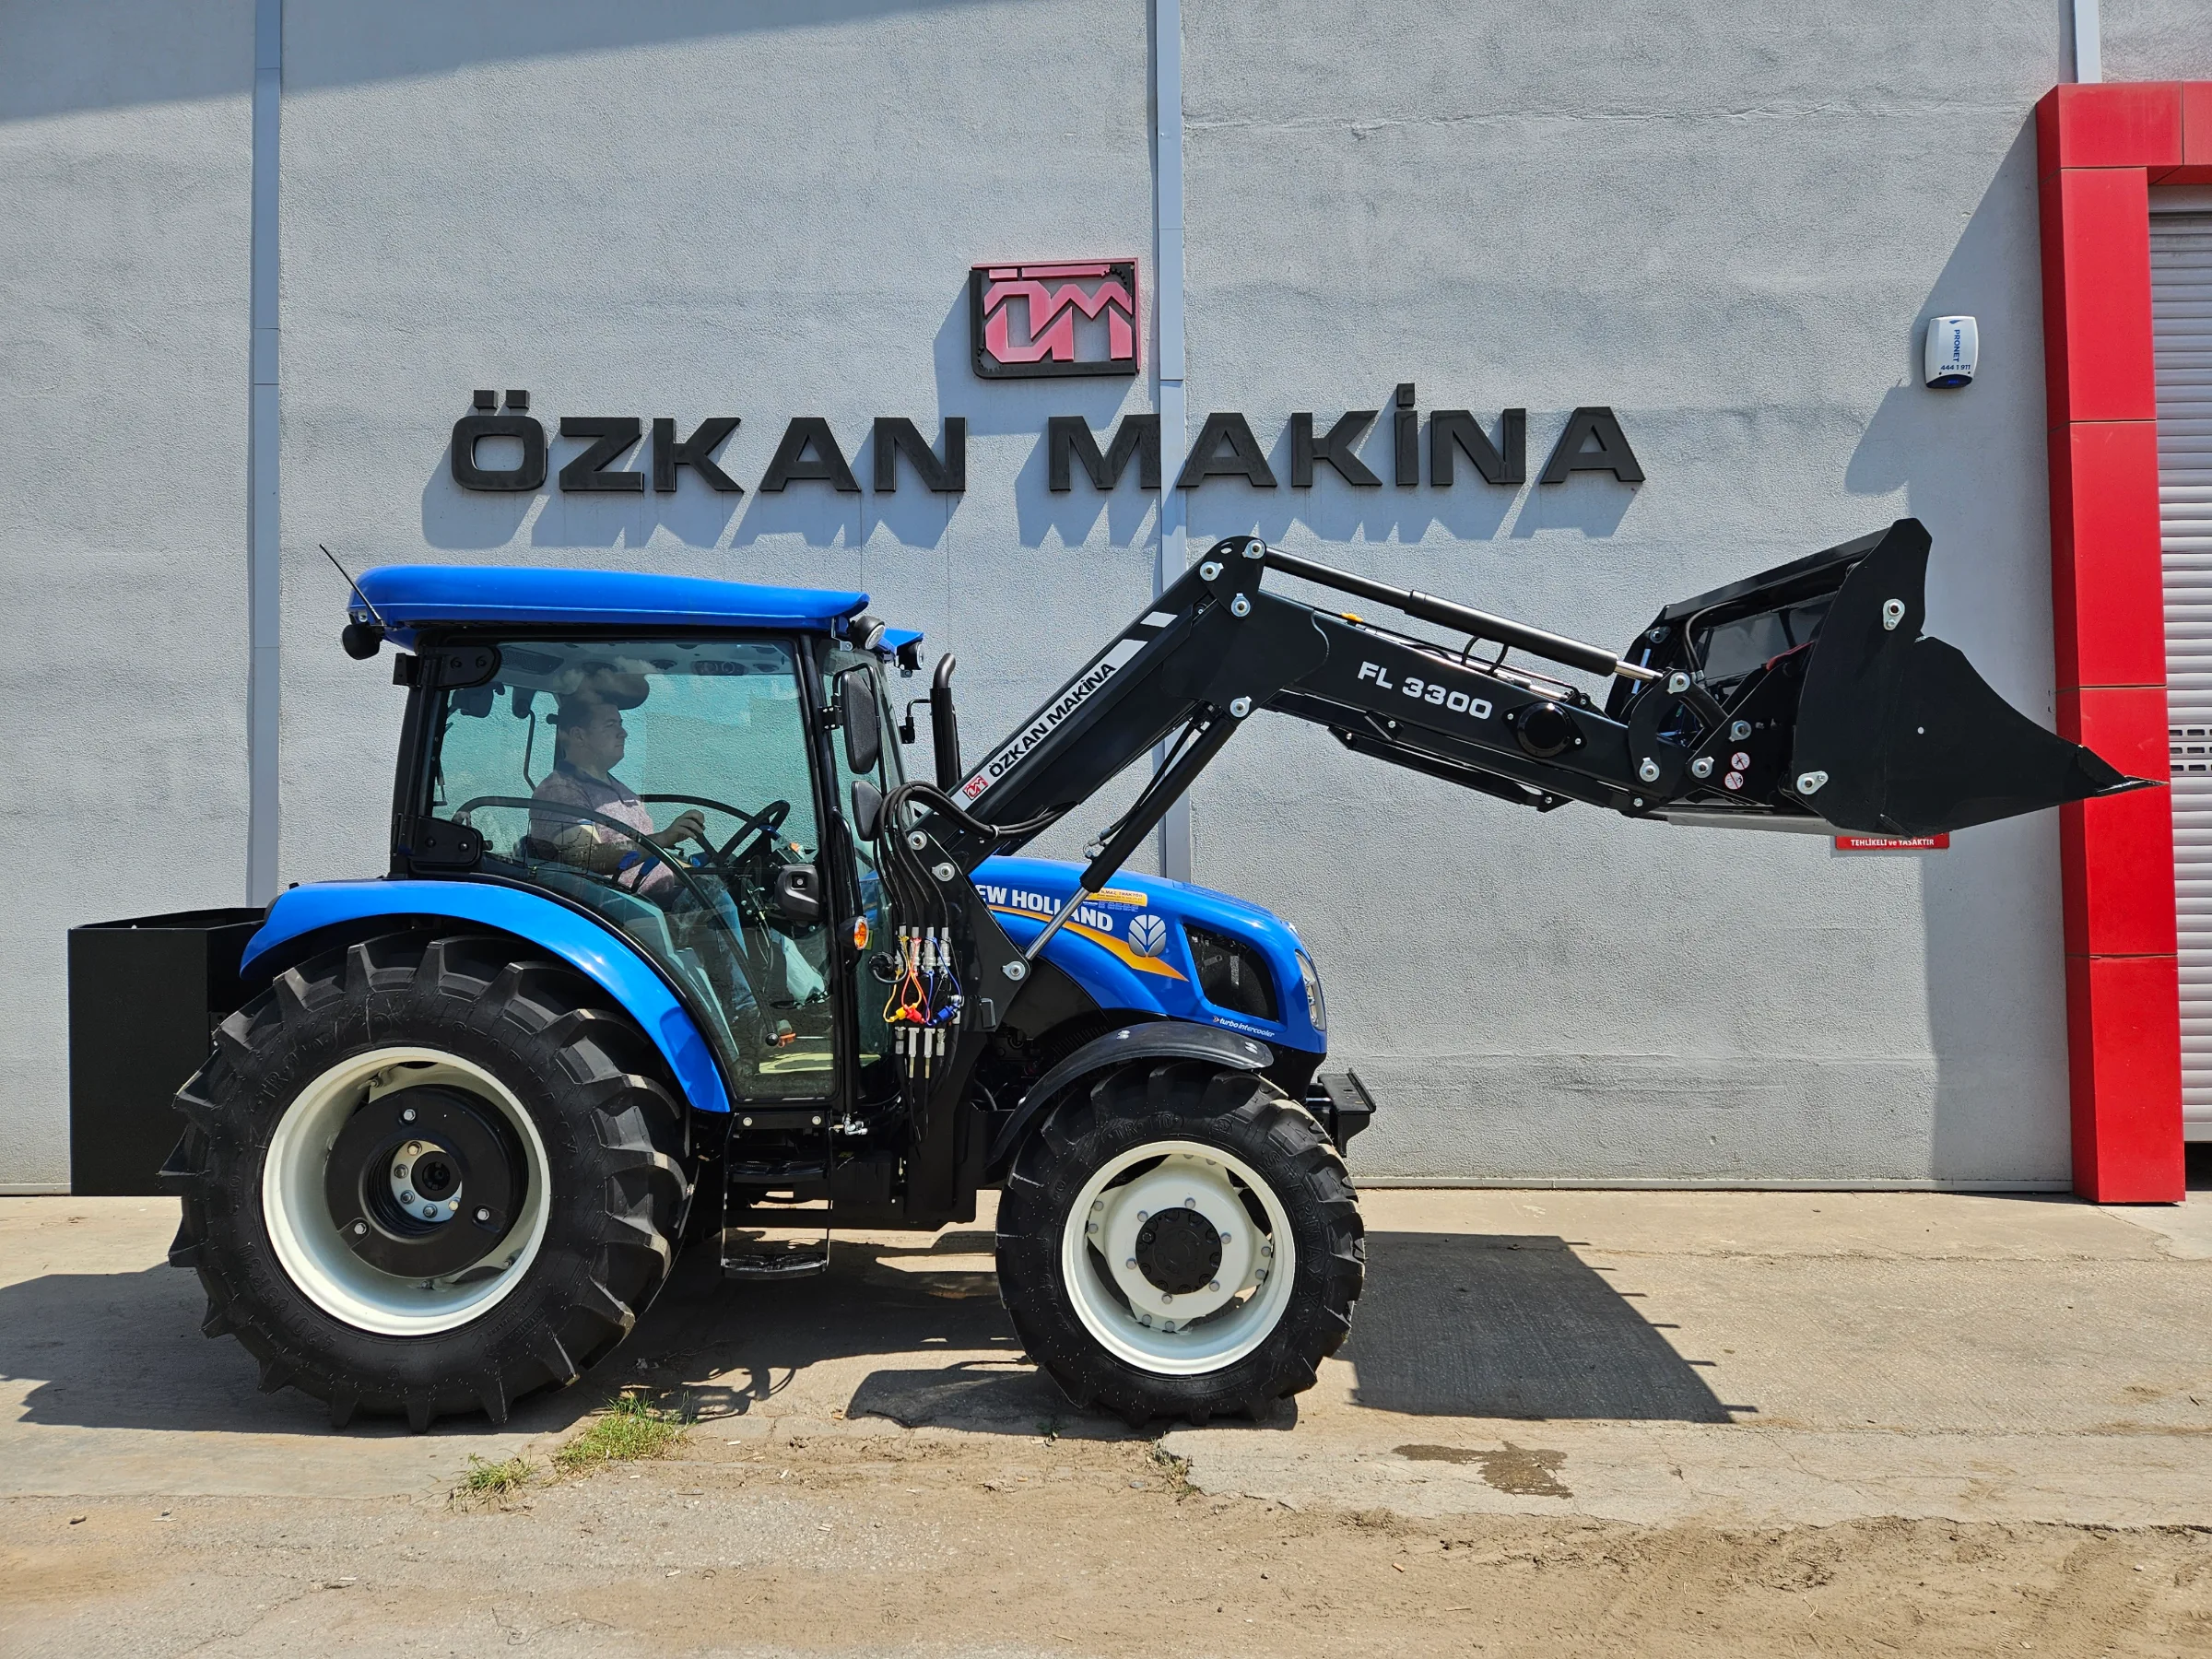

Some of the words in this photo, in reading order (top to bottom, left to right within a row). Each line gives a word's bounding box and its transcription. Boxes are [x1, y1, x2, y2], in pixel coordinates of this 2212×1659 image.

[452, 390, 967, 493] ÖZKAN
[1048, 382, 1647, 491] MAKİNA
[988, 722, 1048, 778] ÖZKAN
[1047, 663, 1117, 725] MAKİNA
[1357, 661, 1394, 689] FL
[1402, 677, 1493, 720] 3300
[975, 884, 1007, 905] EW
[1219, 1018, 1239, 1028] turbo
[1238, 1022, 1275, 1038] intercooler
[1263, 1150, 1324, 1310] STARMAXX
